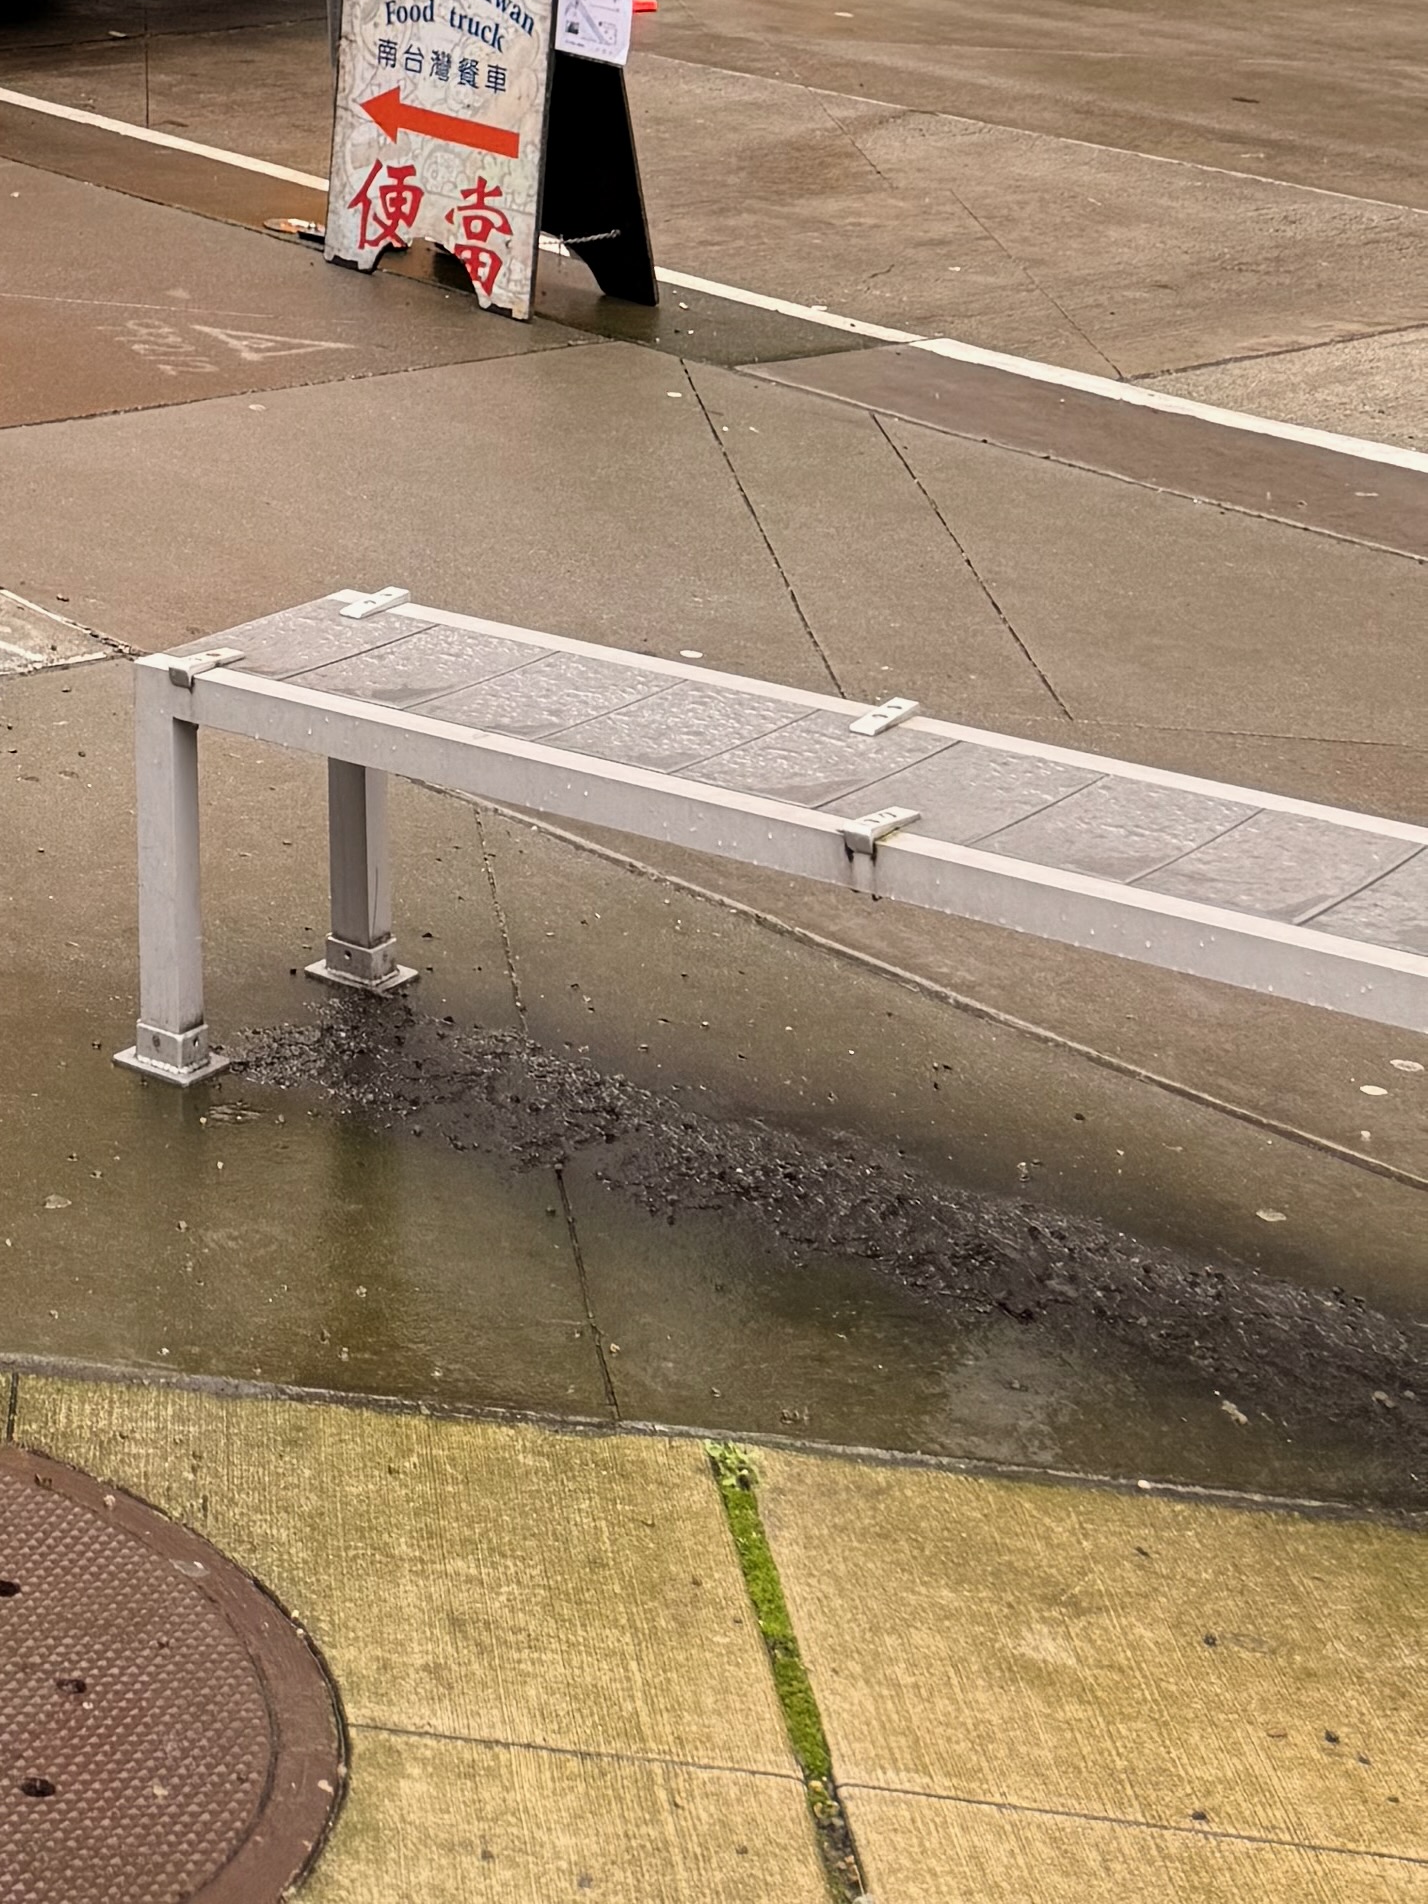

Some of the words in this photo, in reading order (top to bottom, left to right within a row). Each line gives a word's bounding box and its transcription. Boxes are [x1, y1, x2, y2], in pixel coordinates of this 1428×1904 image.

[449, 6, 505, 54] truck
[377, 38, 508, 94] 南台灣餐車
